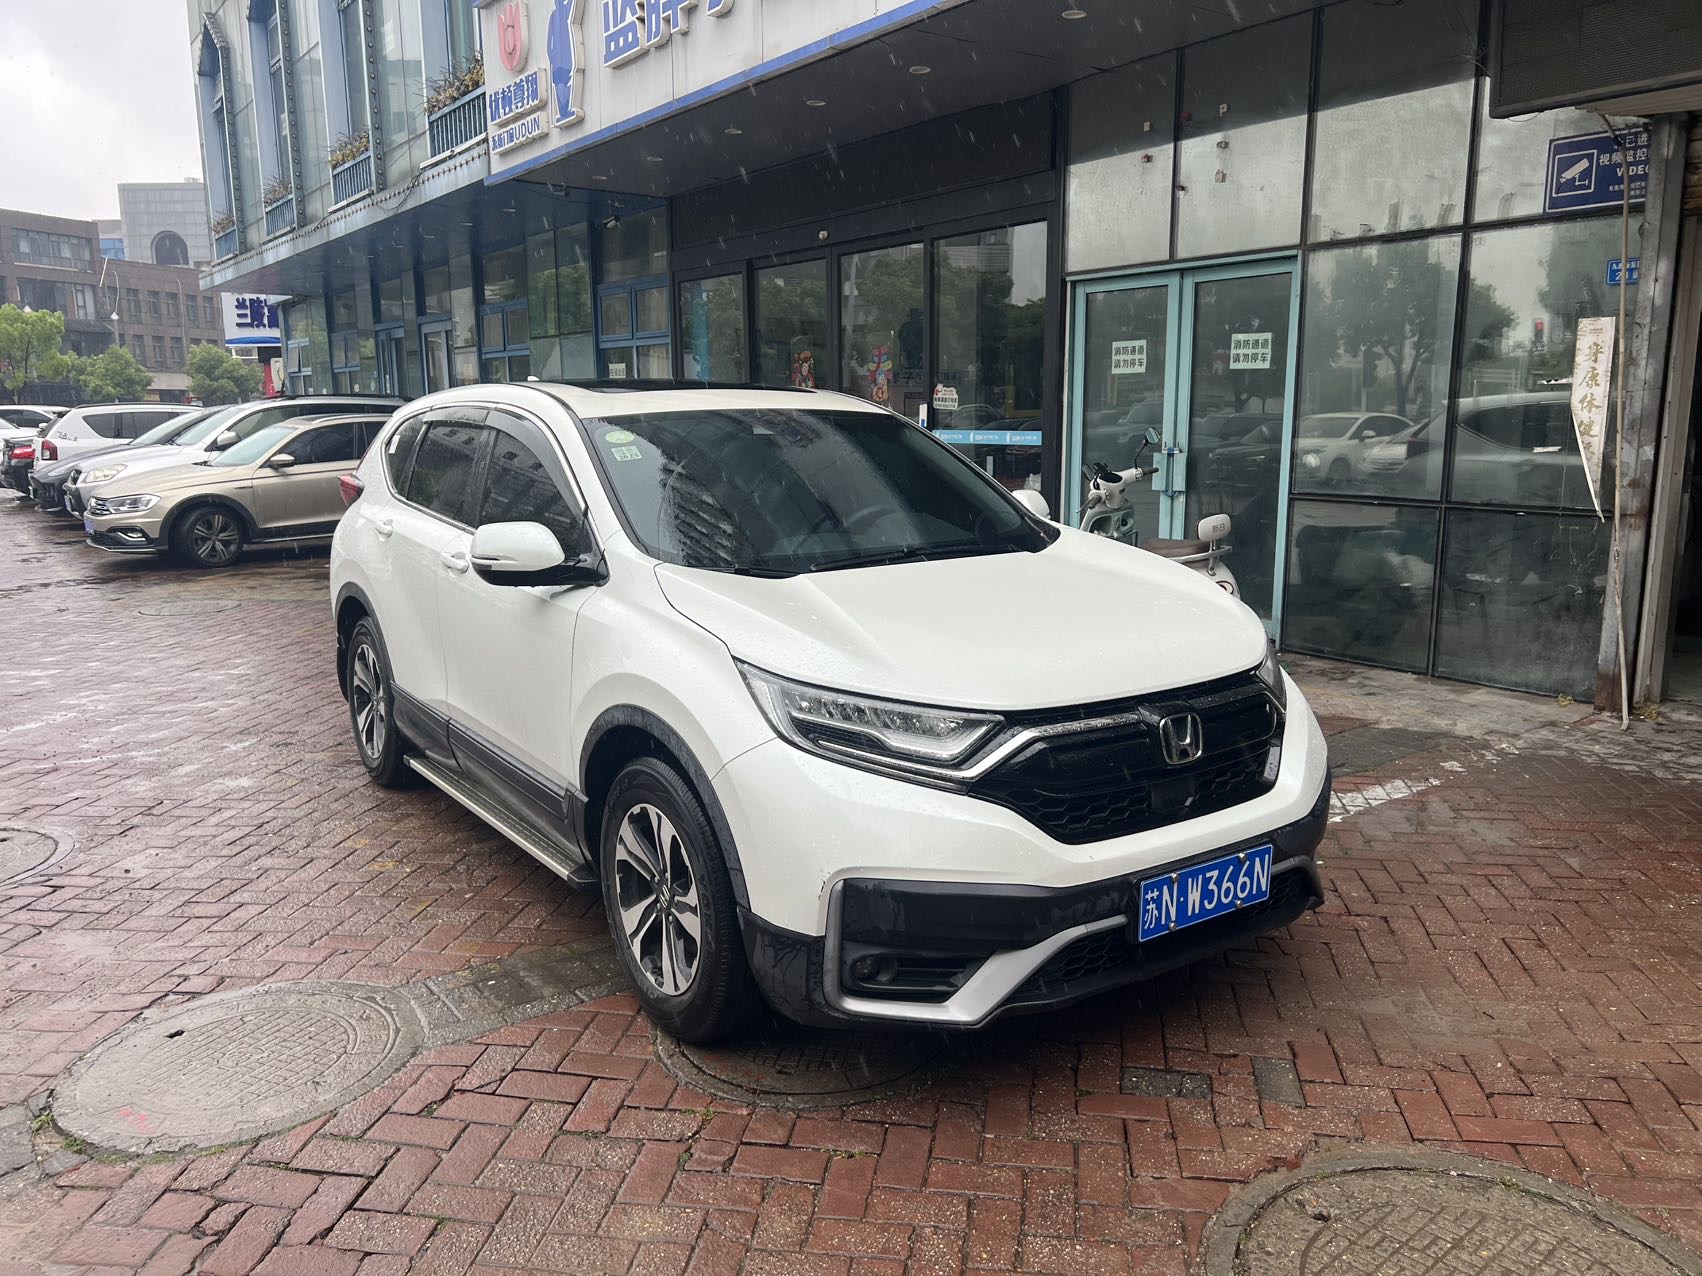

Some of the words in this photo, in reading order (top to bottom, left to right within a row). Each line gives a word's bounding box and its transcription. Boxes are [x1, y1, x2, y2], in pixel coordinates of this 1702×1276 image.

[1233, 338, 1270, 350] 消防通道
[1113, 345, 1145, 356] 消防通道
[1113, 358, 1145, 369] 请勿停车
[1232, 352, 1269, 364] 请勿停车
